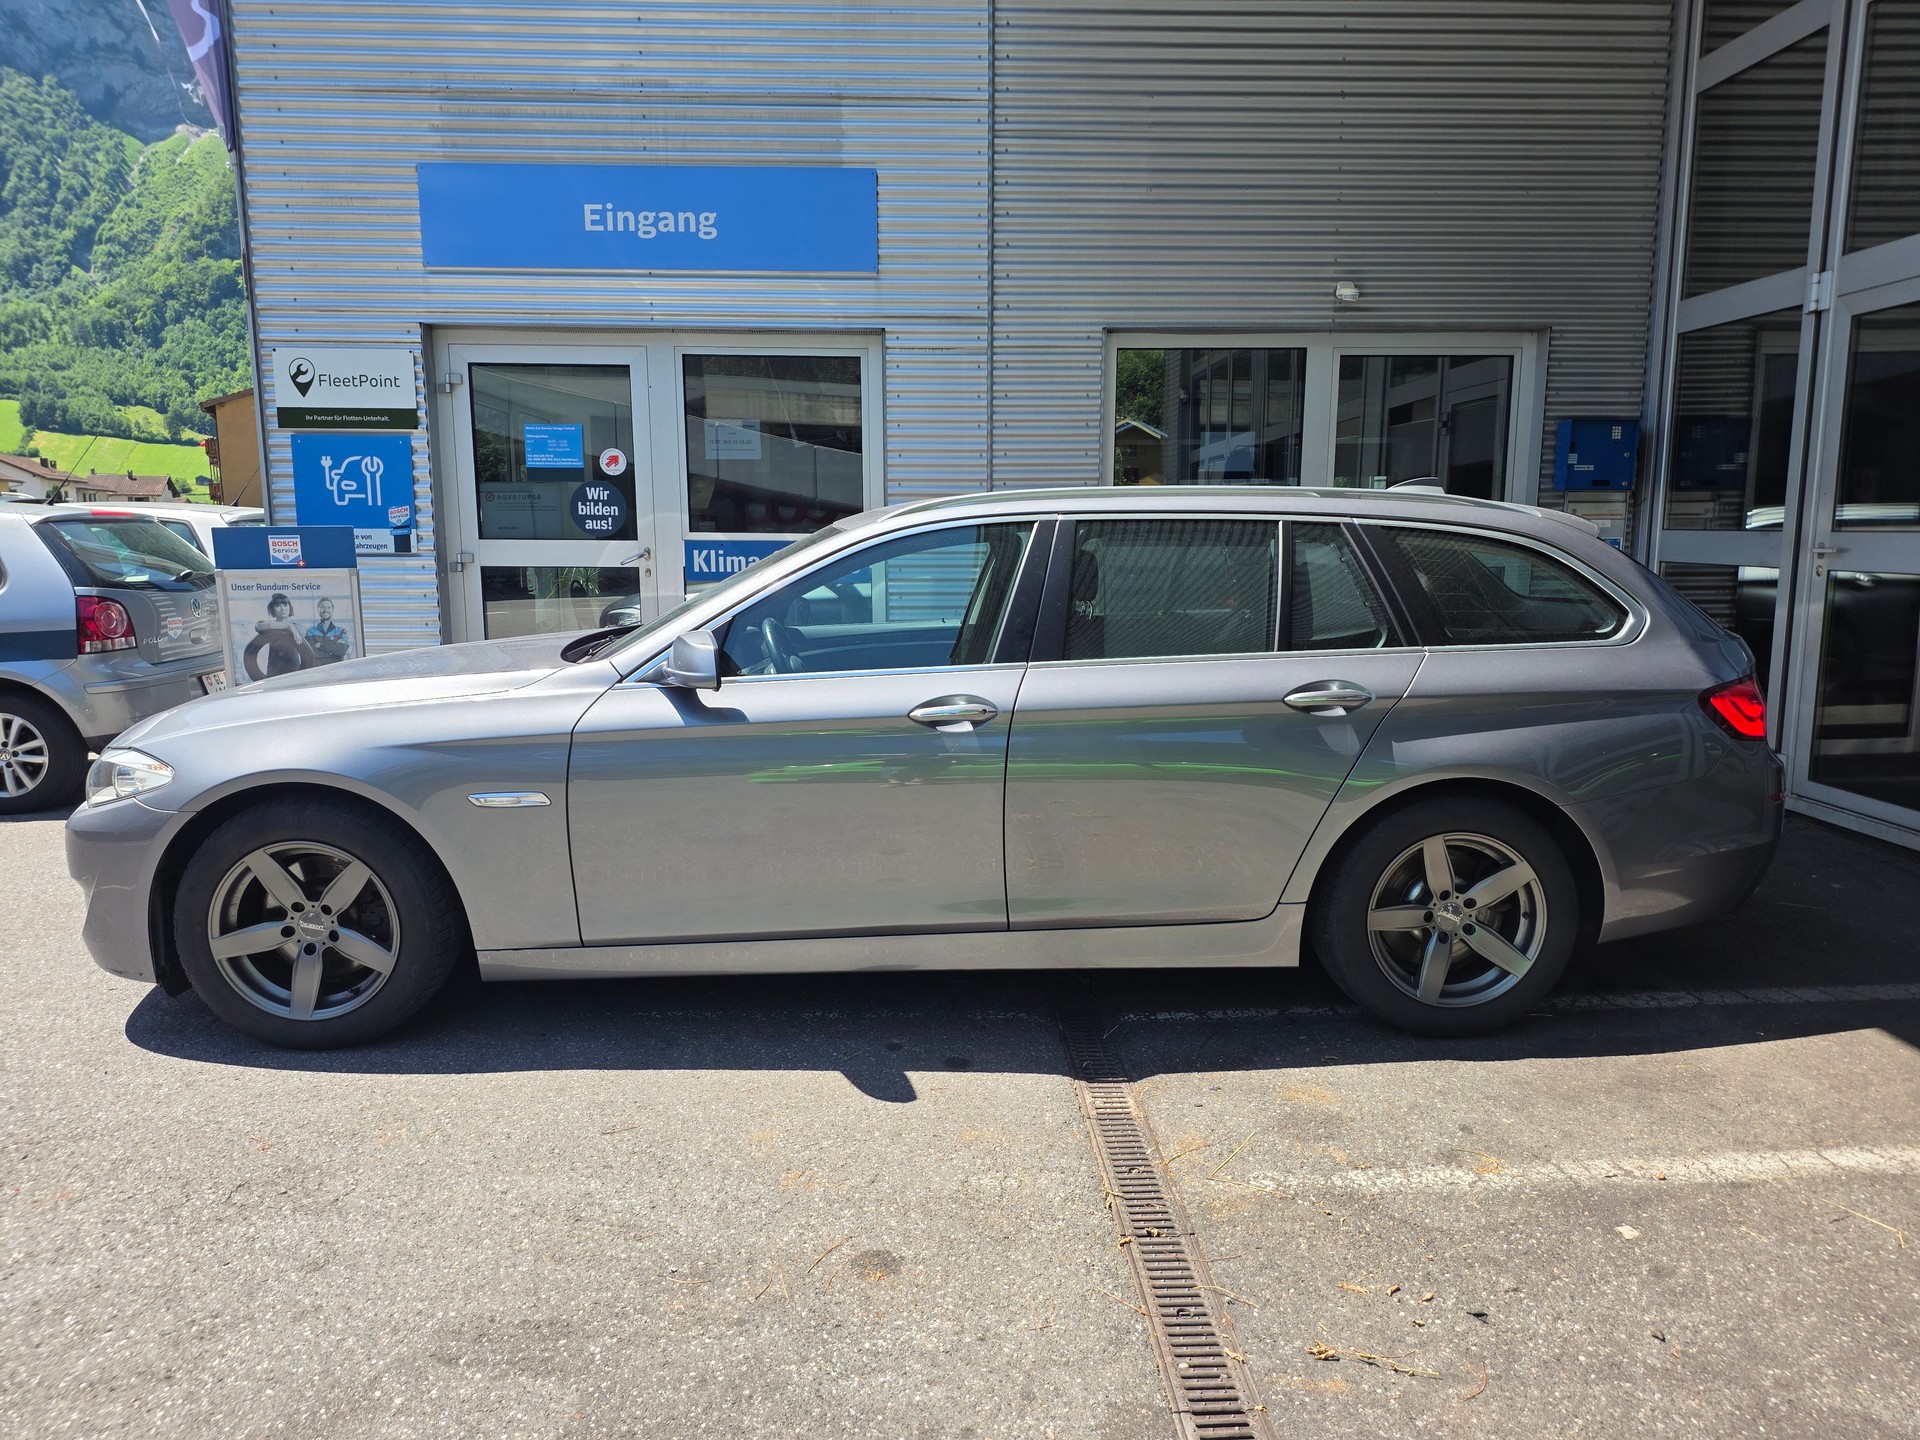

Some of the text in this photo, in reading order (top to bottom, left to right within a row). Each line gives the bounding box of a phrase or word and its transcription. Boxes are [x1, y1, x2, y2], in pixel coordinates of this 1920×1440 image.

[583, 202, 718, 240] Eingang
[318, 374, 400, 388] FleetPoint
[585, 486, 610, 501] Wir
[577, 501, 619, 516] bilden
[585, 517, 613, 531] aus!
[231, 583, 321, 591] Unser Rundum-Service
[143, 636, 162, 644] POLO
[299, 920, 325, 930] DEZENT
